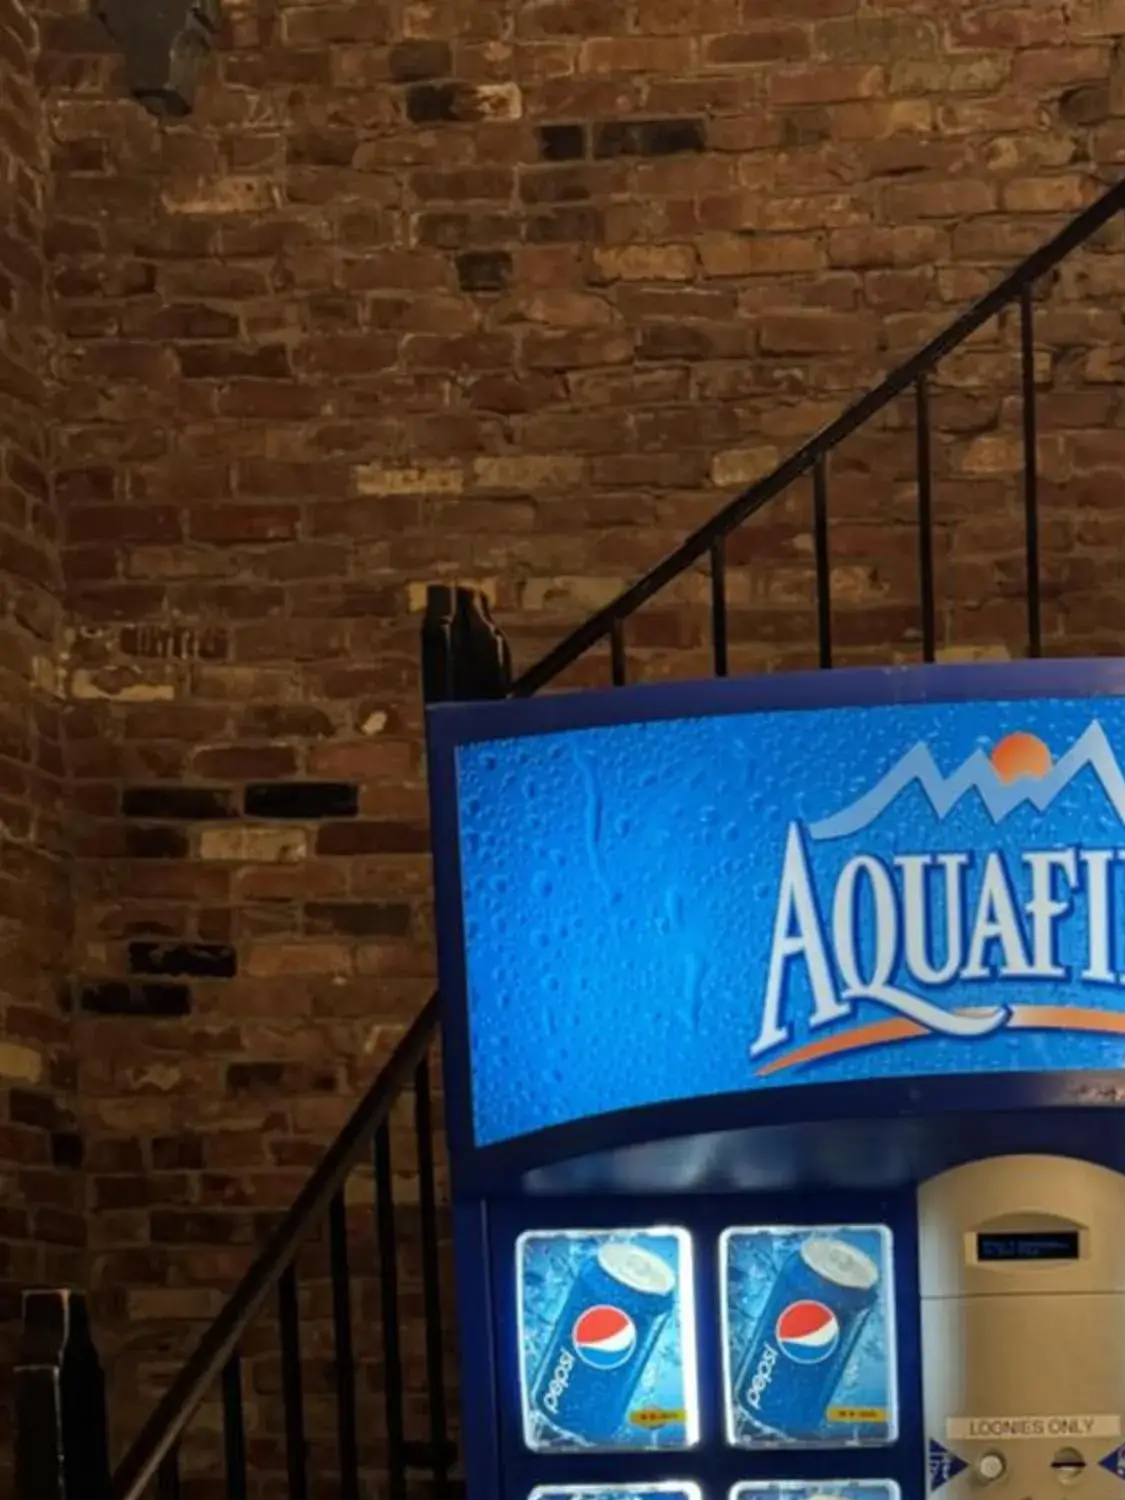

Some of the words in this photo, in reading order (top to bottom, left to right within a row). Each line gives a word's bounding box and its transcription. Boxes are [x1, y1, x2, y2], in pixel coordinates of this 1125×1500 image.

[543, 1348, 576, 1413] pepsi
[746, 1343, 779, 1410] pepsi
[969, 1419, 1044, 1436] LOONIES
[1050, 1417, 1095, 1435] ONLY
